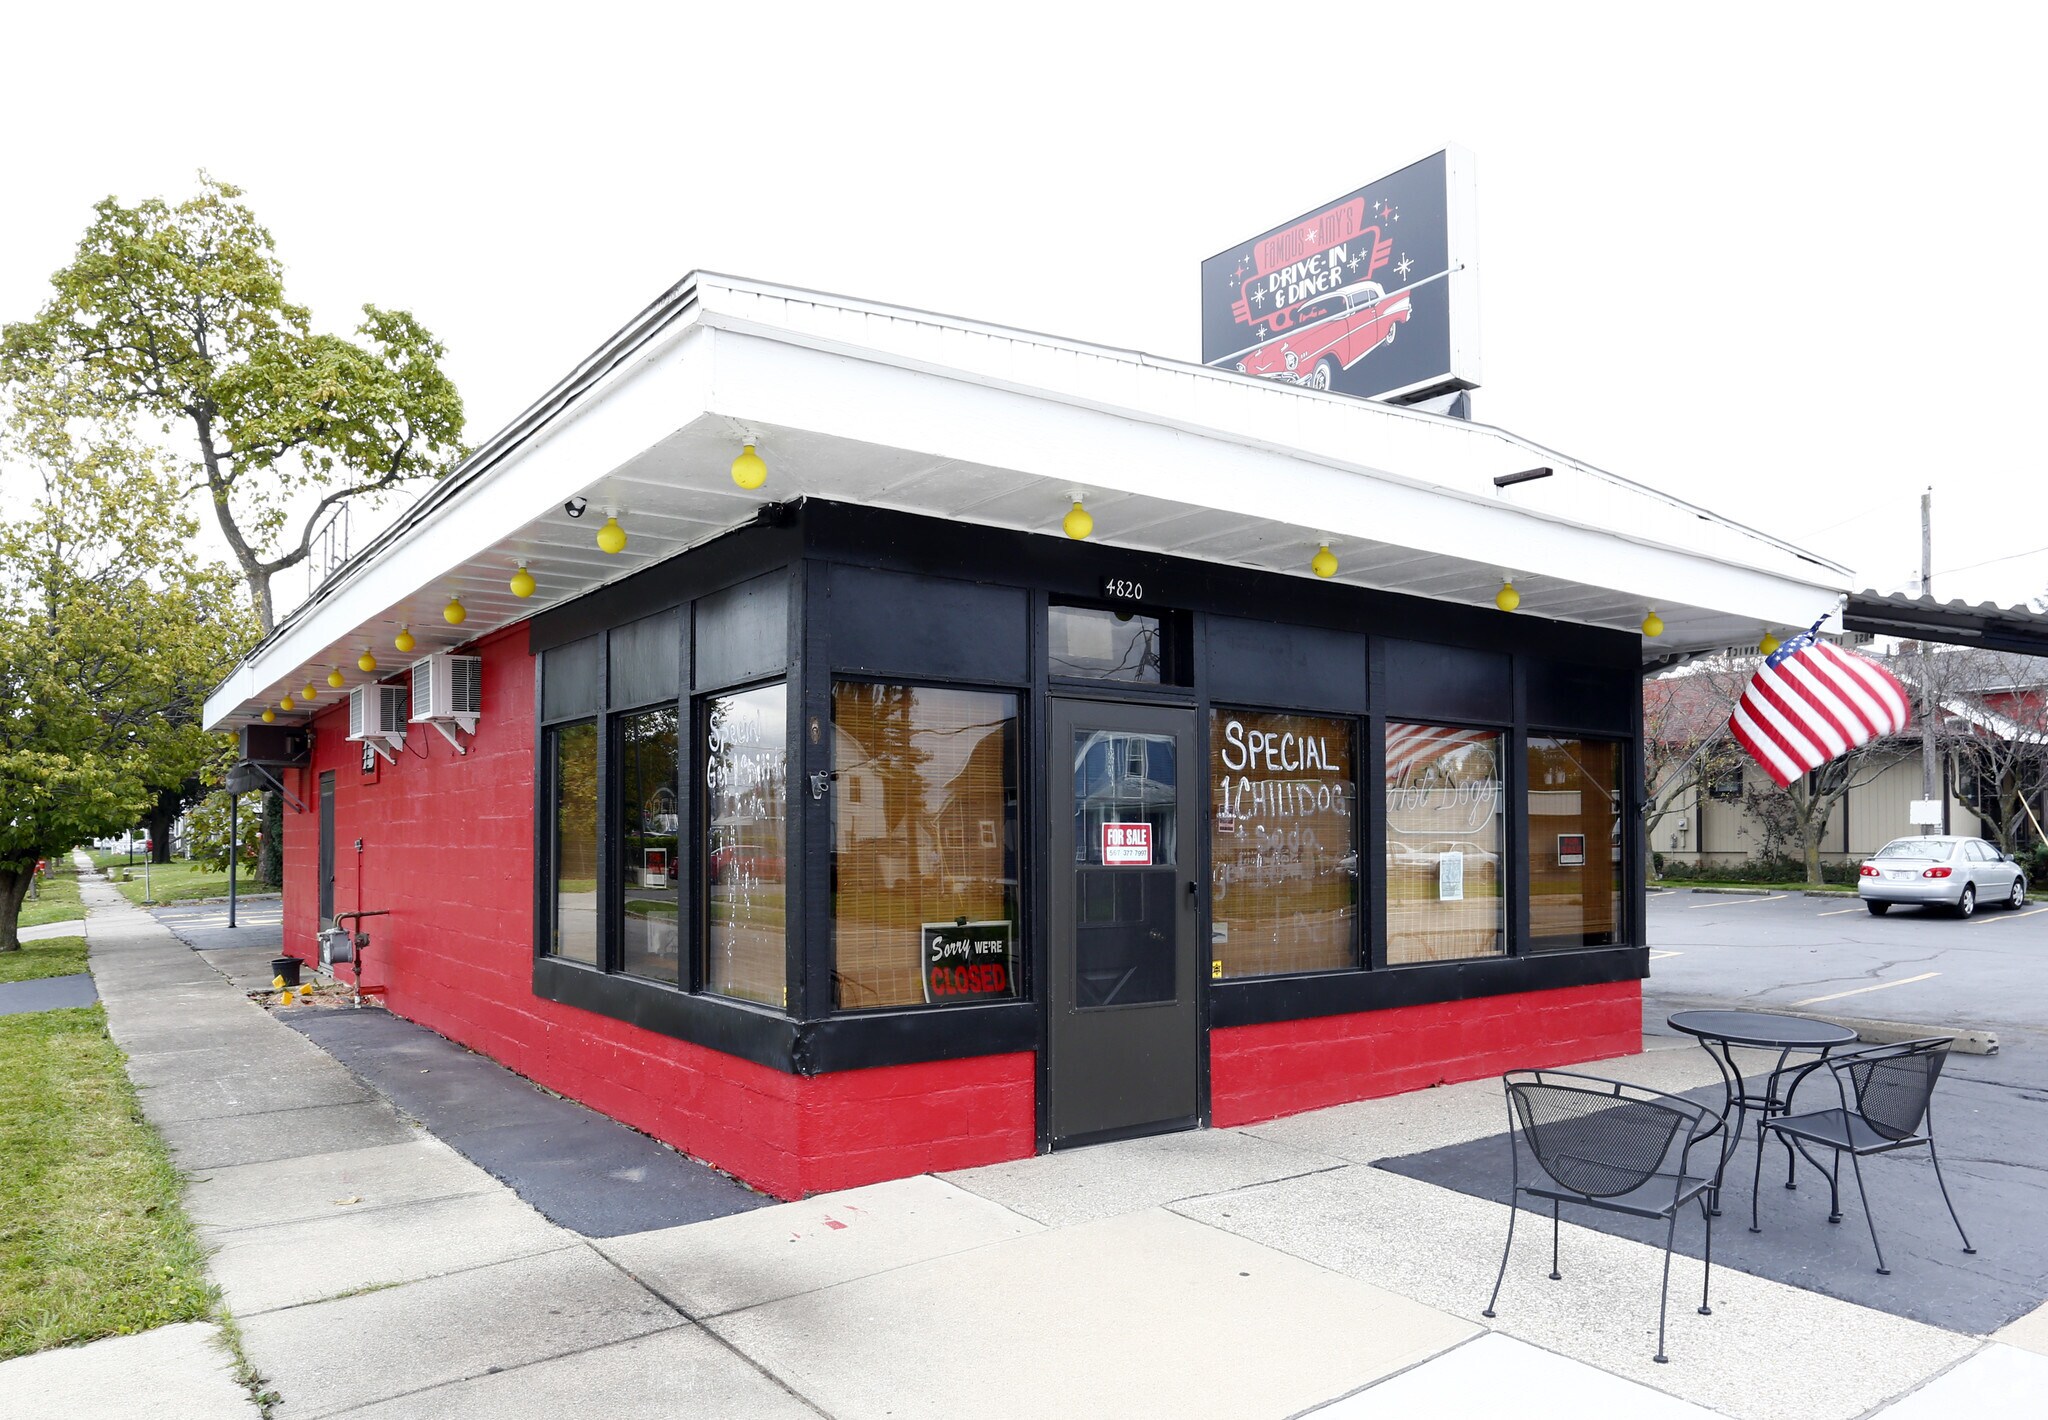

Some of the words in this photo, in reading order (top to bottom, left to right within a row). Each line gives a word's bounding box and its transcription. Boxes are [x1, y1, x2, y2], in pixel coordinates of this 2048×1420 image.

[1264, 229, 1304, 269] FAMOUS
[1318, 207, 1353, 246] AMY'S
[1269, 243, 1347, 292] DRIVE-IN
[1275, 290, 1285, 308] &
[1288, 266, 1342, 304] DINER
[1106, 578, 1143, 600] 4820
[1222, 720, 1340, 771] SPECIAL
[1217, 775, 1236, 818] 1
[1107, 828, 1124, 846] FOR
[1126, 828, 1147, 846] SALE
[931, 936, 970, 962] Sorry
[974, 940, 1003, 955] WE'RE
[930, 963, 1007, 996] CLOSED
